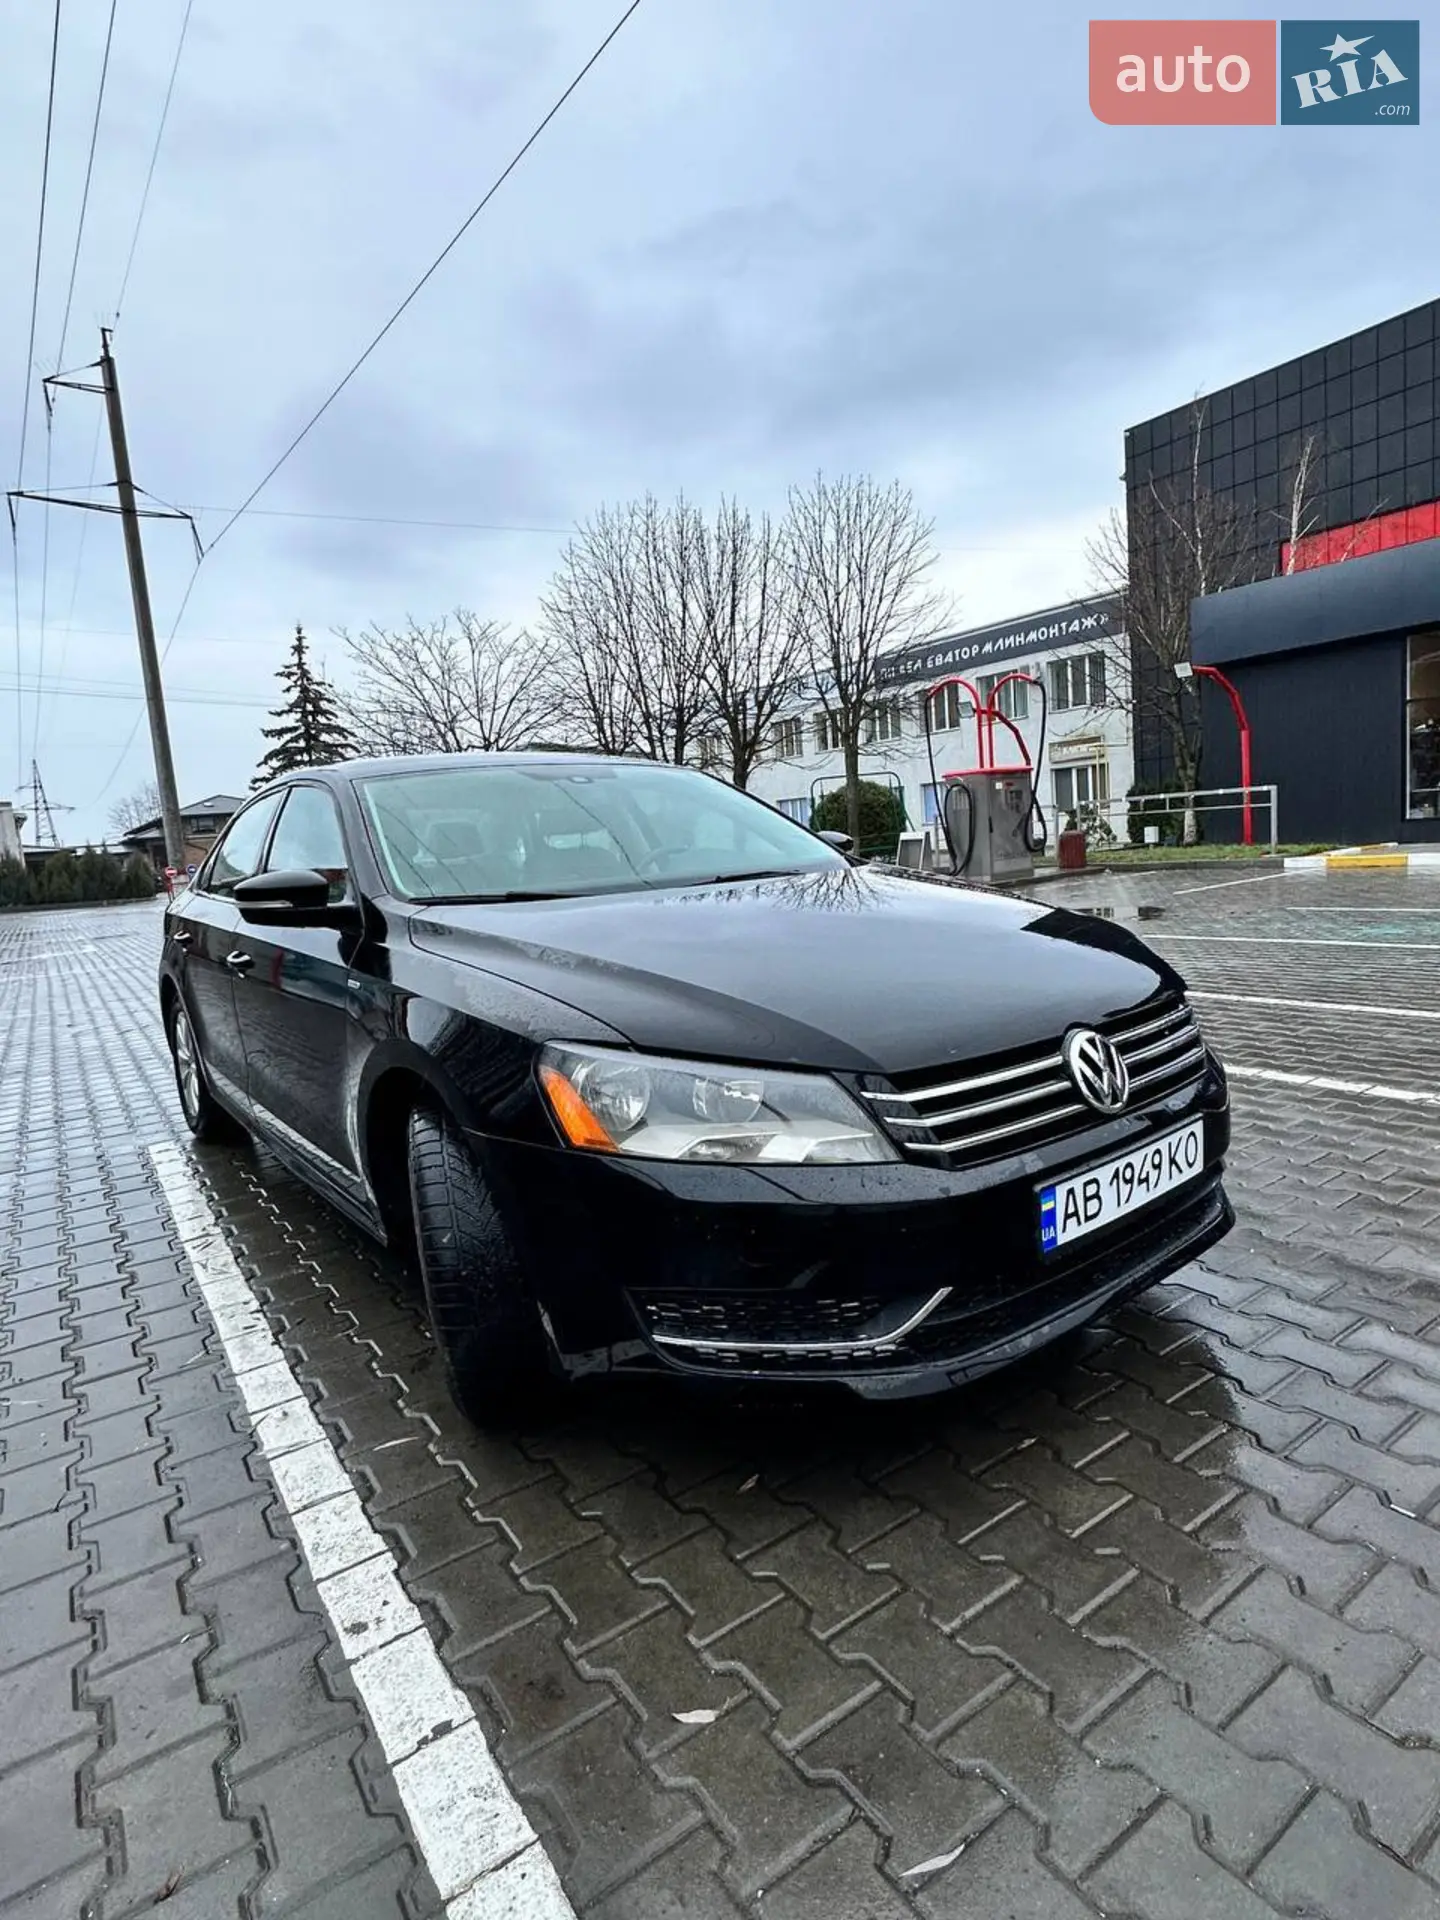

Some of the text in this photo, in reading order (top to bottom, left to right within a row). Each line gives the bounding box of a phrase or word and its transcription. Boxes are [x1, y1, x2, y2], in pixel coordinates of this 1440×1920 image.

[1061, 1130, 1199, 1234] AB 1949 KO
[1041, 1227, 1056, 1242] UA
